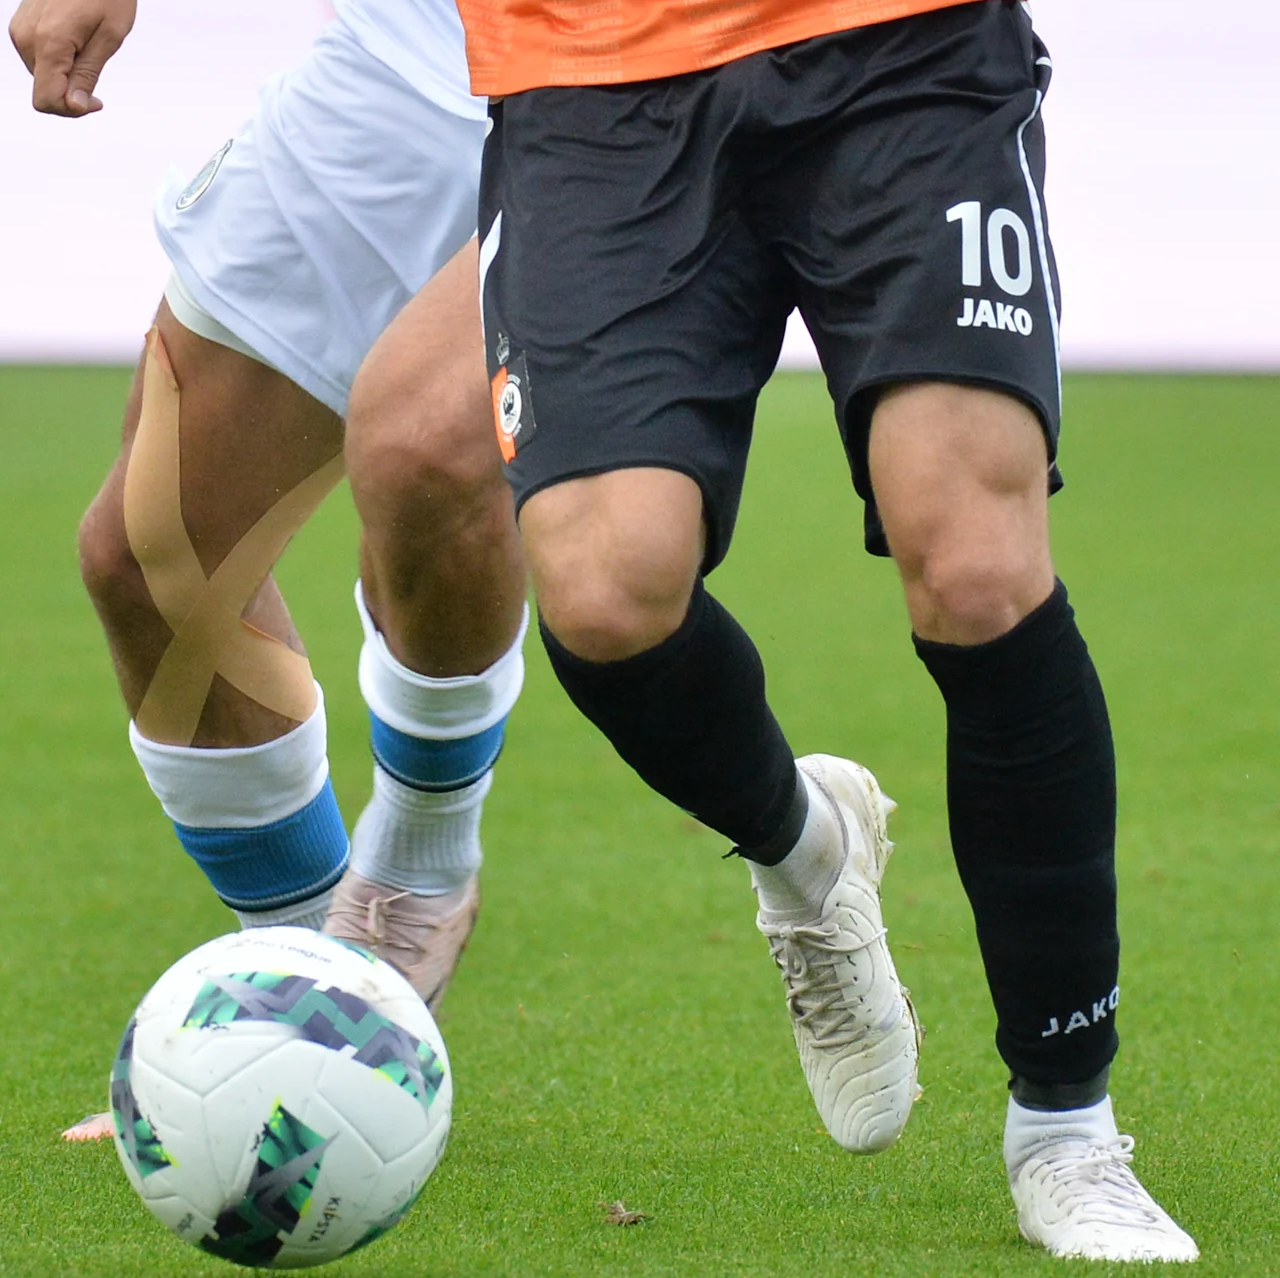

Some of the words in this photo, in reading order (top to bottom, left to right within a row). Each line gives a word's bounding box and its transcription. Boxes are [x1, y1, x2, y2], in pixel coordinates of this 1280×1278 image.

[946, 201, 1032, 296] 10
[957, 298, 1033, 336] JAKO
[1041, 985, 1120, 1038] JAKO
